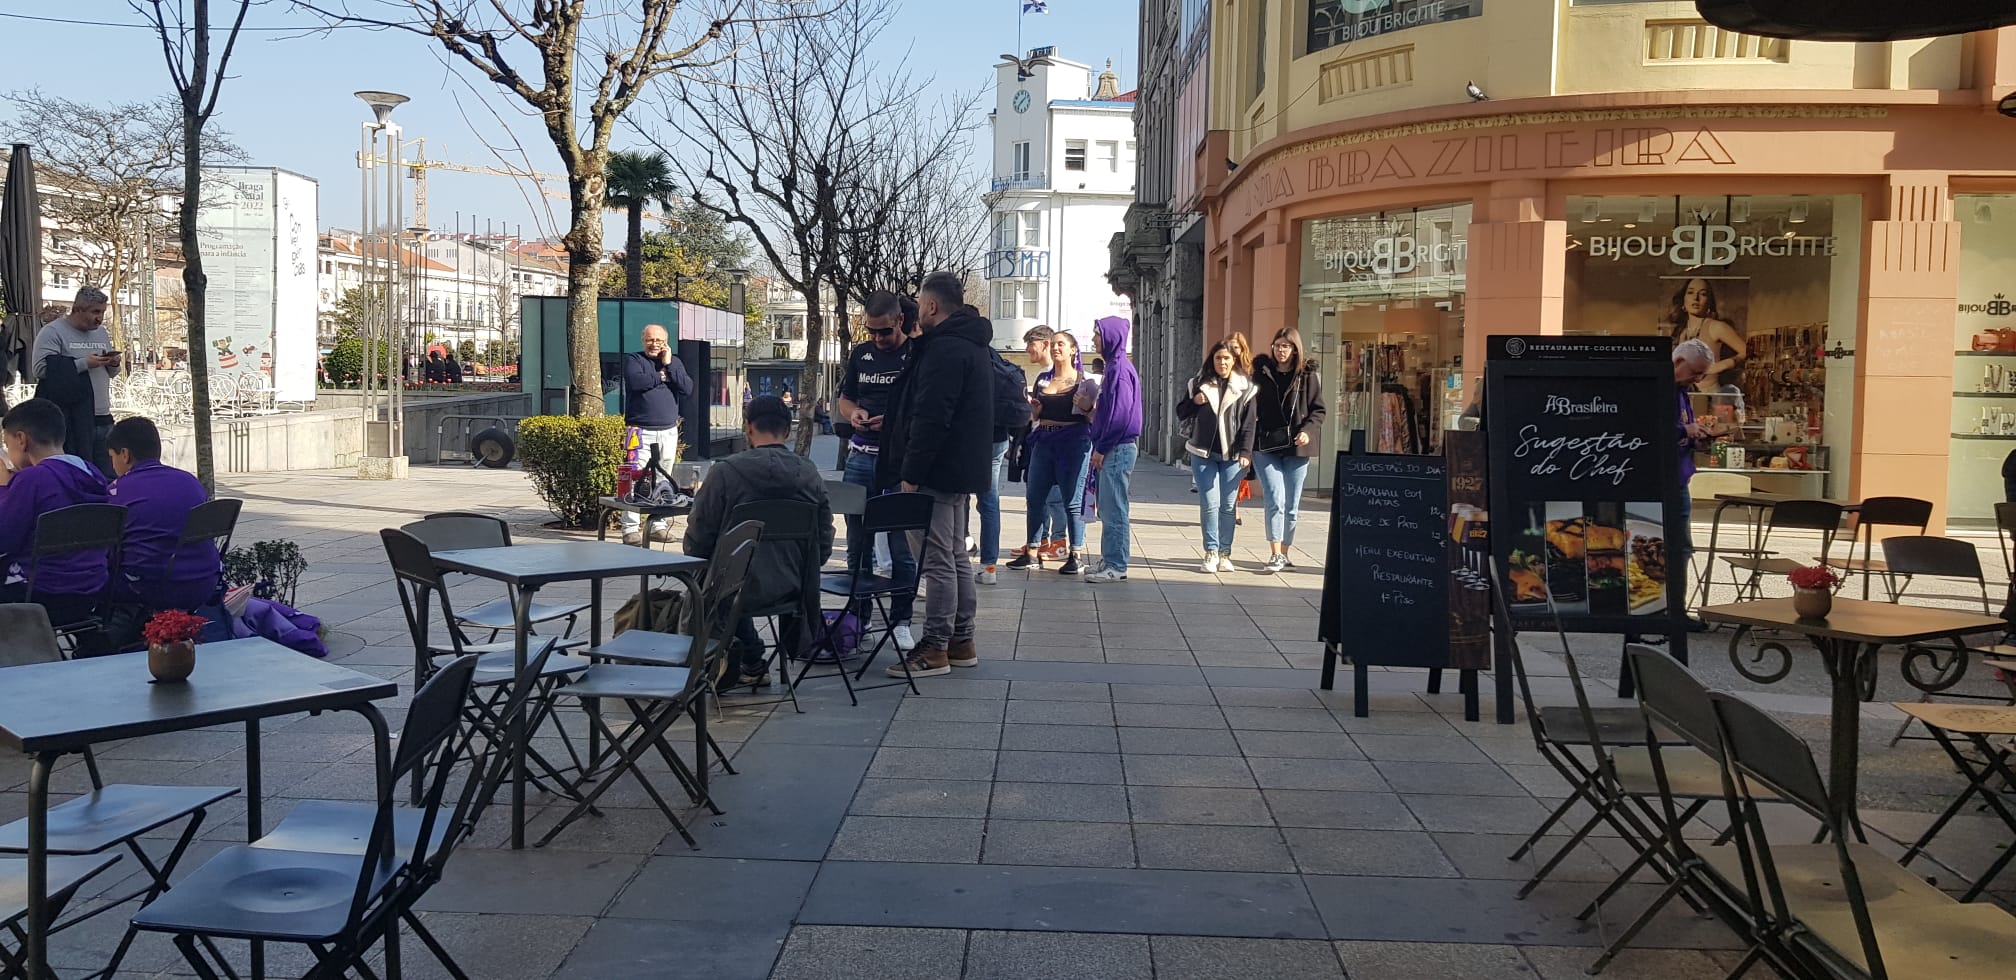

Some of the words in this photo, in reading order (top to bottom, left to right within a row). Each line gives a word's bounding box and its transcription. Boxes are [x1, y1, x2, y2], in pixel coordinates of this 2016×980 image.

[1341, 19, 1379, 41] BIJOU
[1384, 1, 1446, 30] BRIGITTE
[238, 182, 264, 191] Braga
[241, 202, 264, 210] 2022
[1588, 236, 1666, 261] BIJOU
[1324, 250, 1372, 273] BIJOU
[1514, 424, 1648, 458] Sugestão
[1530, 456, 1561, 475] do
[1569, 454, 1634, 485] Chef
[1451, 476, 1483, 491] 1927
[1368, 498, 1400, 508] NATAS
